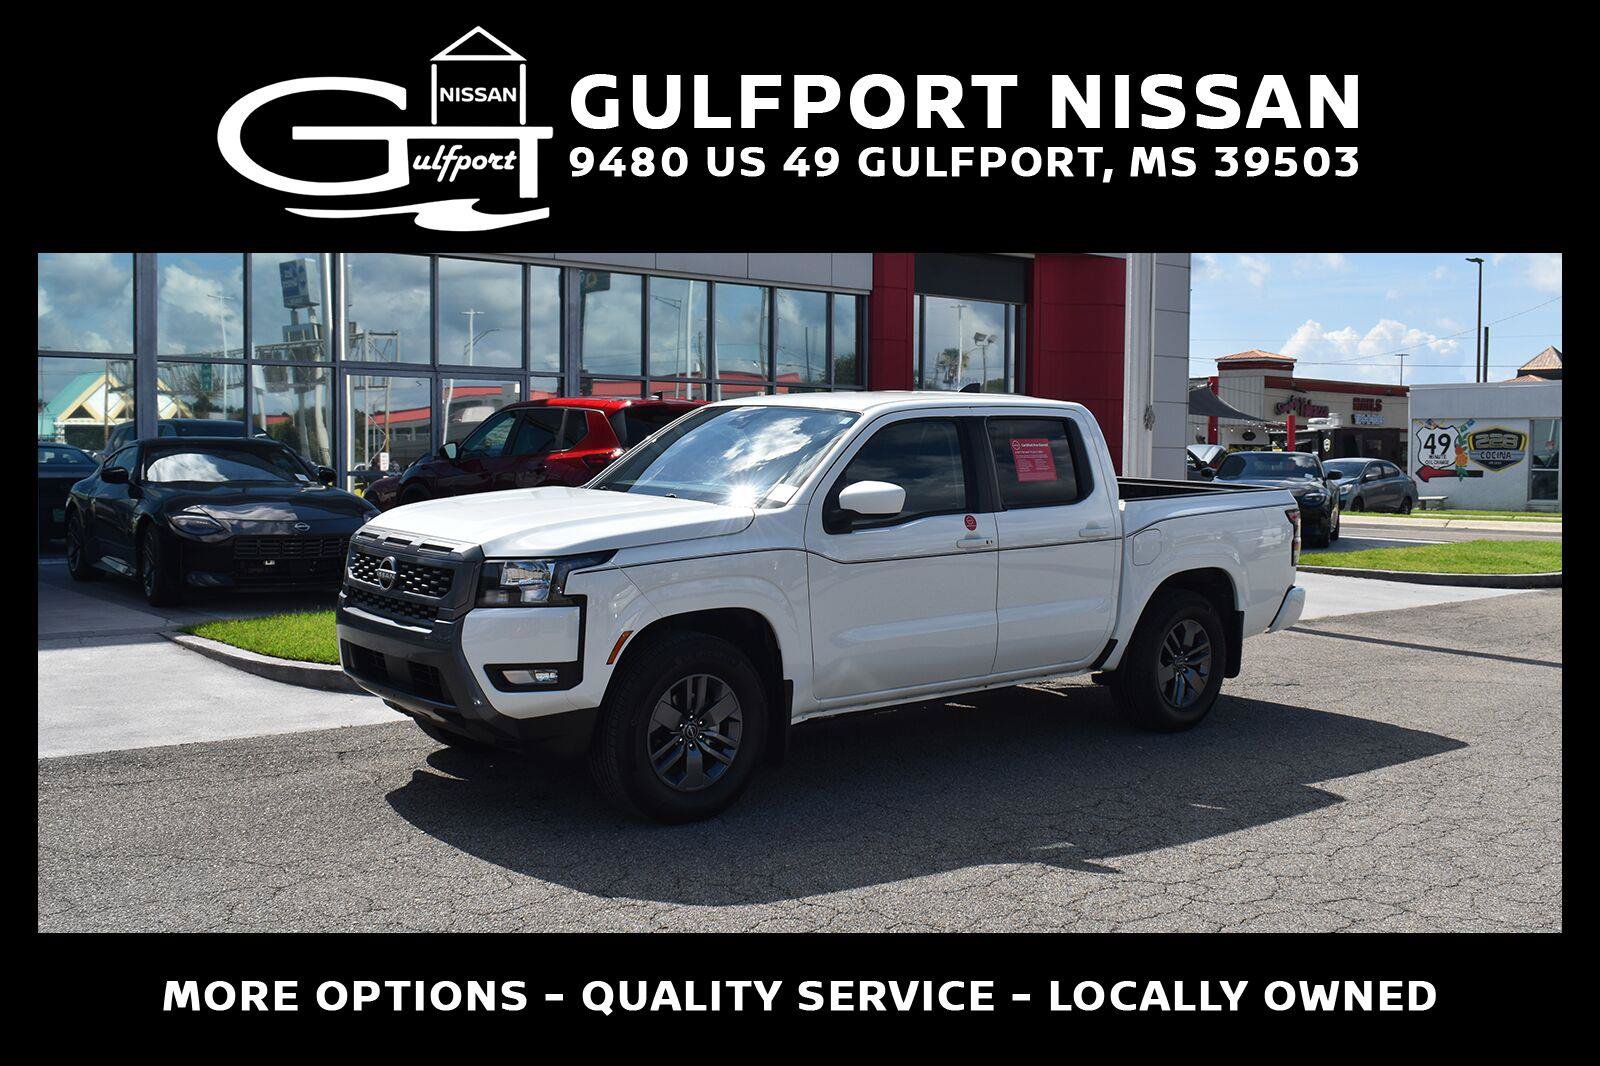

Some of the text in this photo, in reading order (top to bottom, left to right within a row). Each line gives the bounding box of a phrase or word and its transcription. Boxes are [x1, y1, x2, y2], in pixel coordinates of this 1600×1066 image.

[1423, 433, 1452, 456] 49
[1475, 433, 1519, 449] 228
[1480, 450, 1512, 461] COCINA
